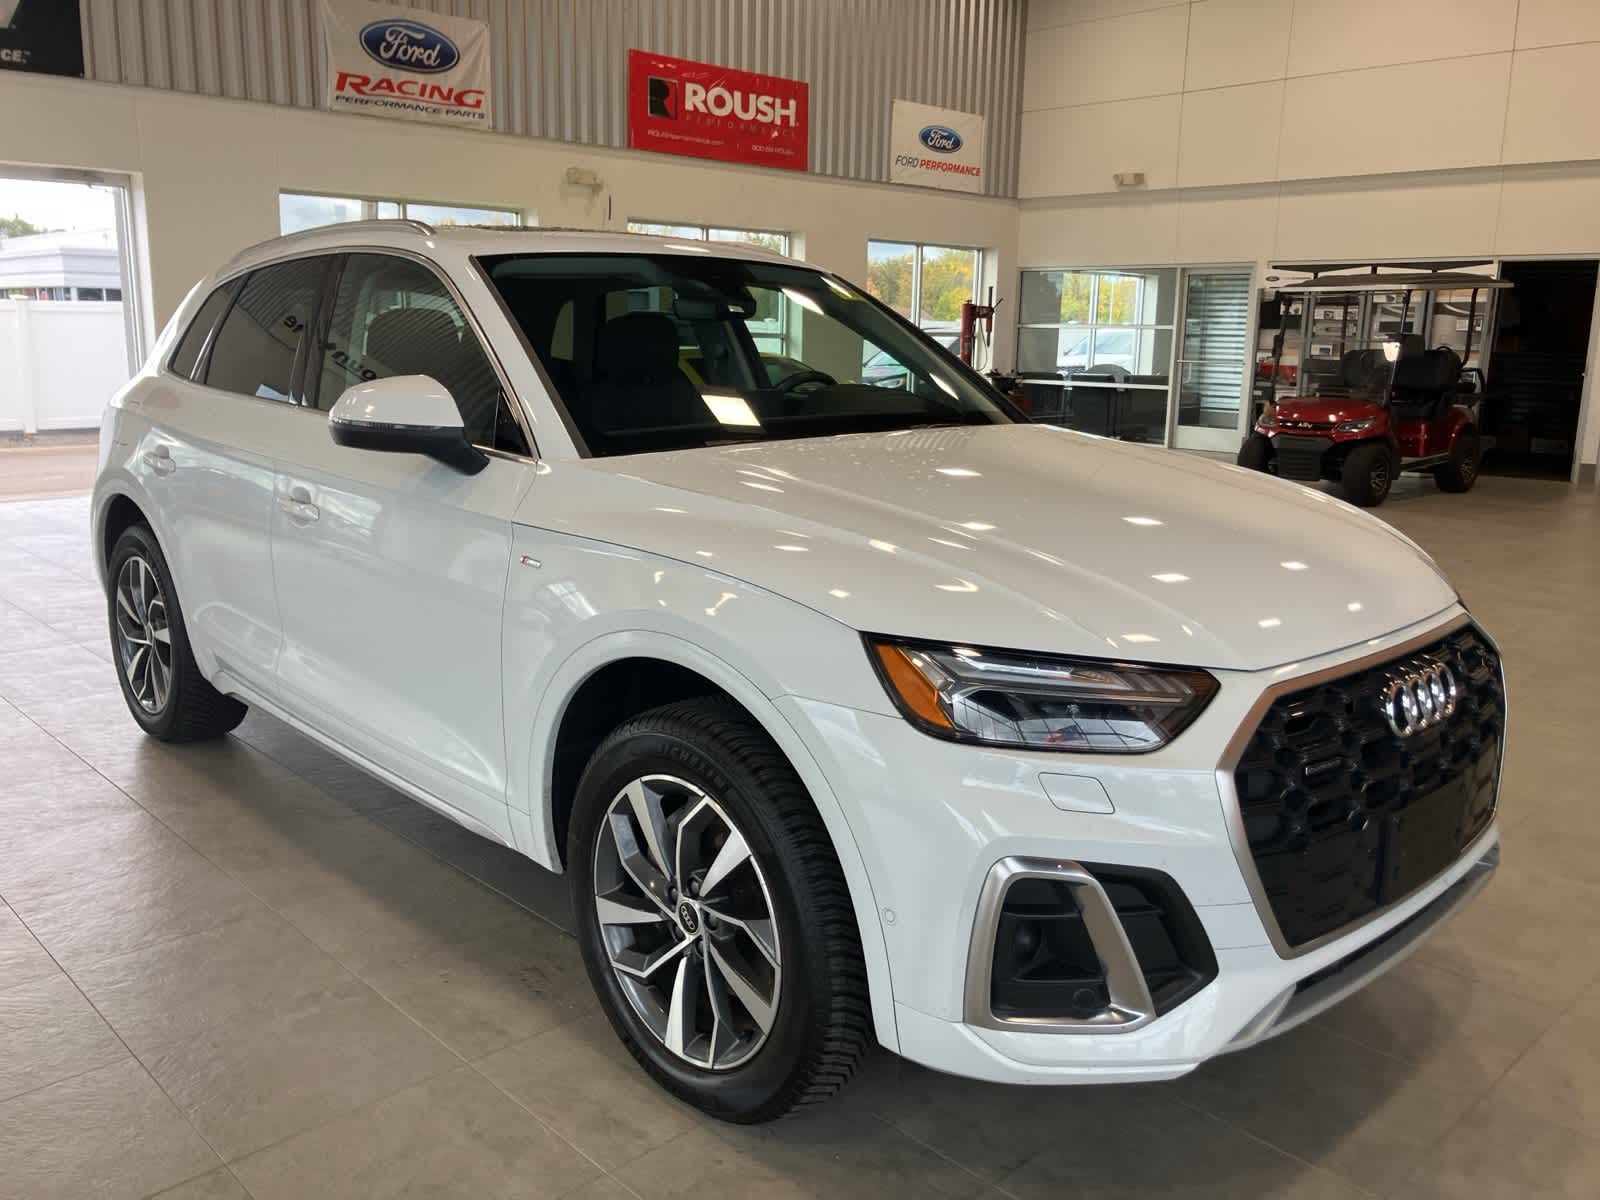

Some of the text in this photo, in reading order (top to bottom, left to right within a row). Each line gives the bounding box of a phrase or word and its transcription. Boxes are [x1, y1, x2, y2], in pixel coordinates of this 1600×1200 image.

[379, 26, 441, 67] Ford
[335, 71, 485, 109] RACING
[684, 81, 798, 127] ROUSH
[335, 95, 485, 120] PERFORMANCE PARTS
[927, 129, 954, 149] Ford
[895, 155, 981, 177] FORD PERFORMANCE
